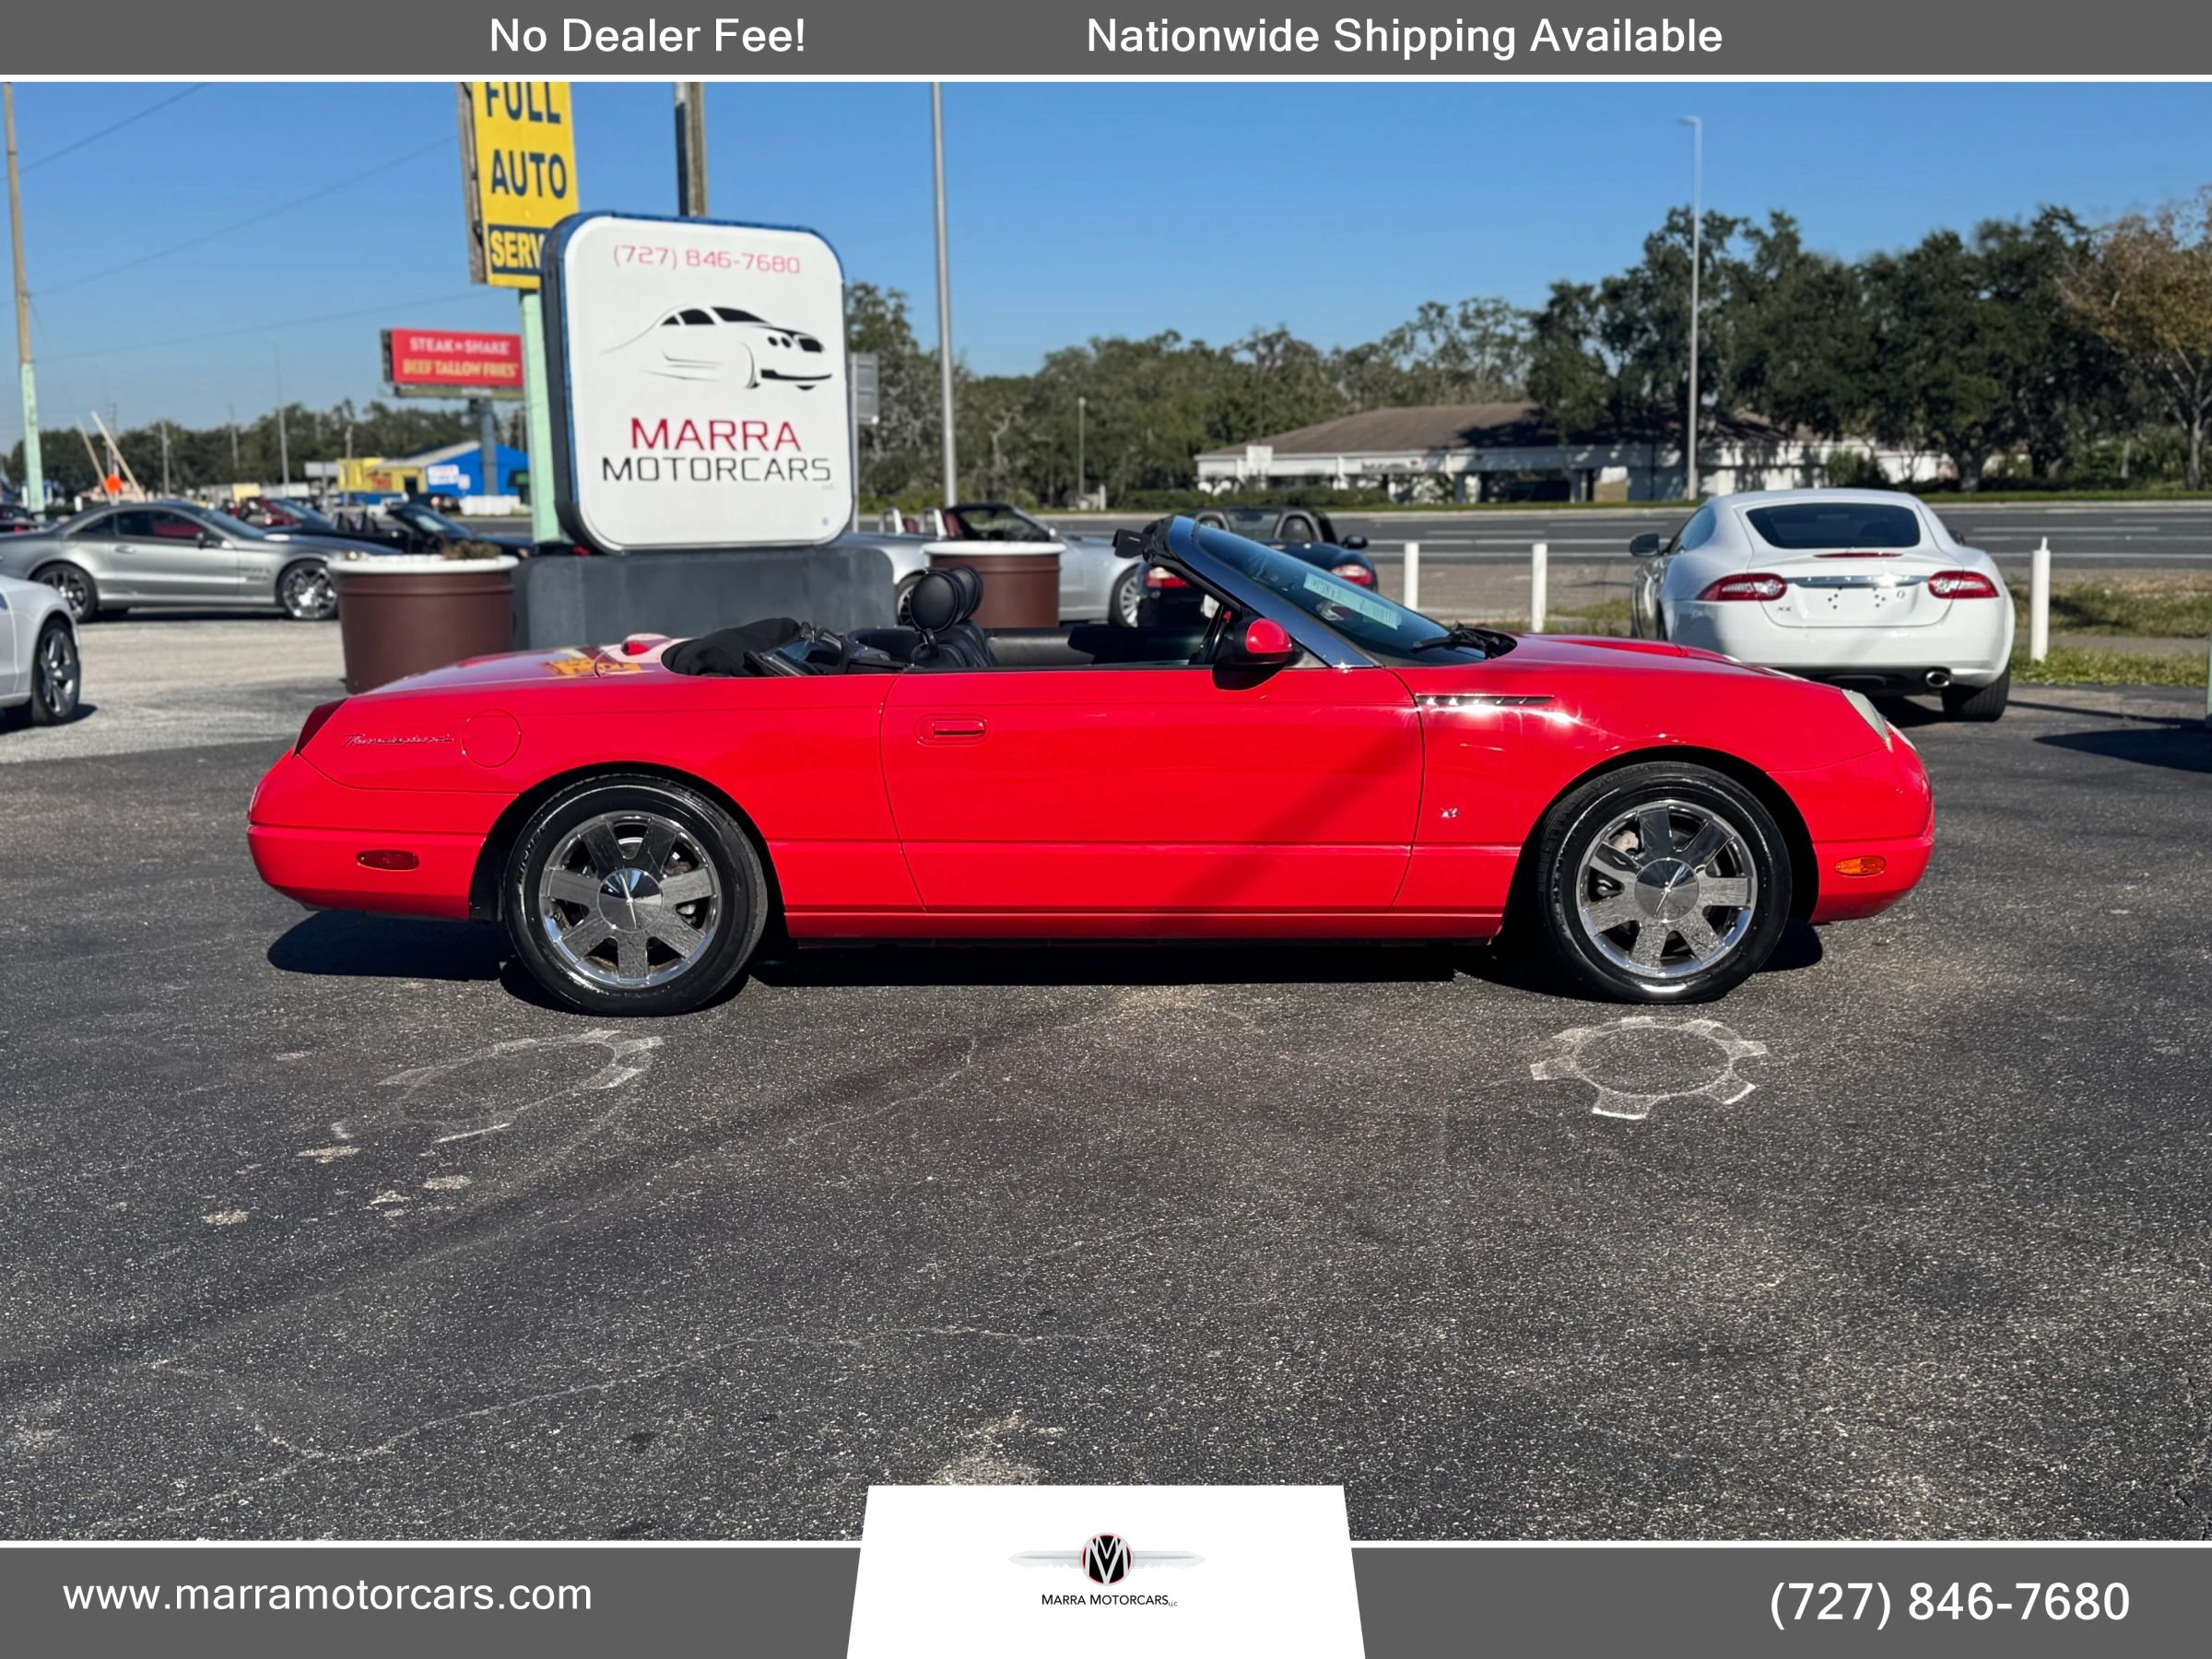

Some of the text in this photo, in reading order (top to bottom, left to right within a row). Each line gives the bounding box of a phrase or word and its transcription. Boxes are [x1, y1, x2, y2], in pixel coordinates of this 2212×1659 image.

[485, 82, 561, 124] FULL
[491, 148, 568, 200] AUTO
[613, 244, 801, 275] (727) 846-7680
[409, 336, 453, 352] STEAK
[464, 339, 510, 356] SHAKE
[630, 417, 802, 452] MARRA
[601, 456, 831, 482] MOTORCARS
